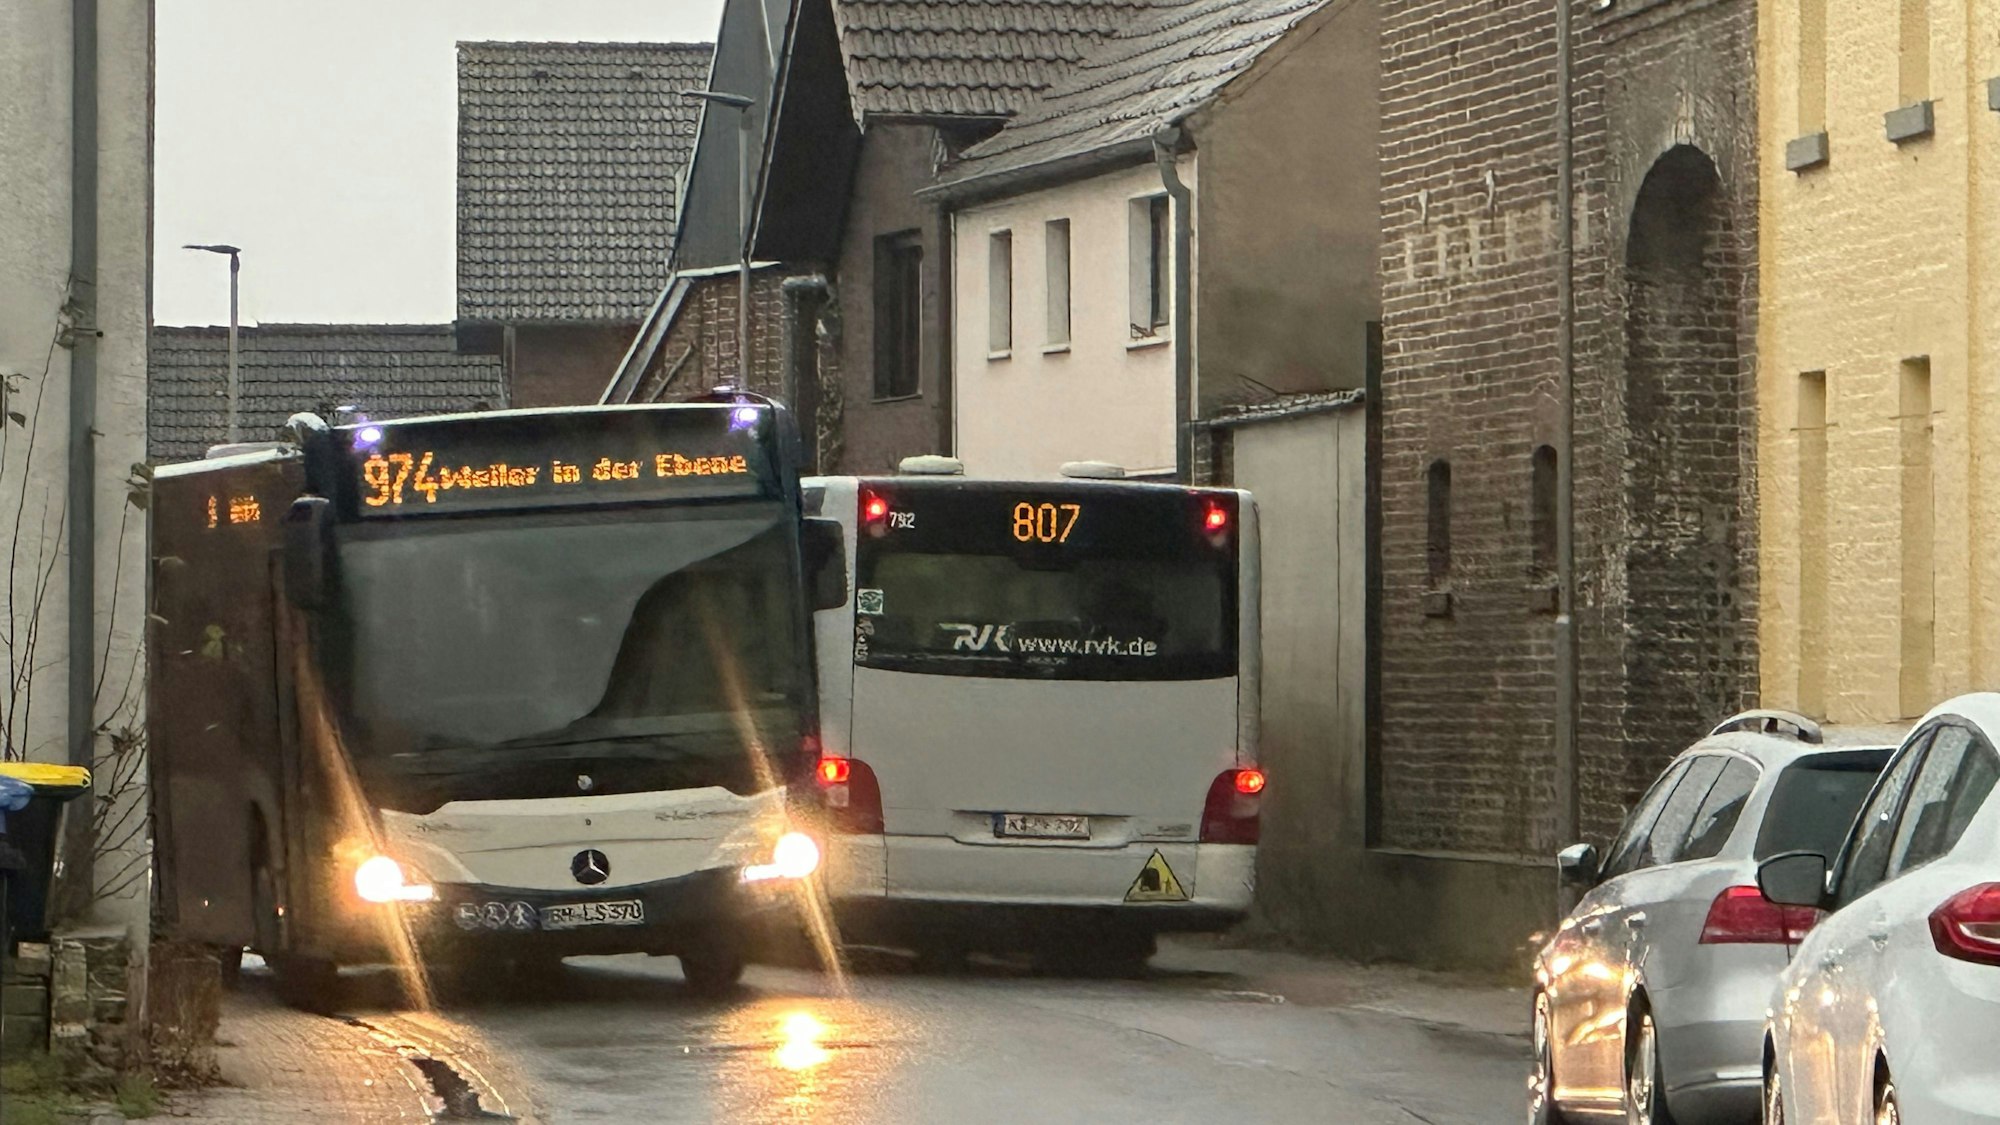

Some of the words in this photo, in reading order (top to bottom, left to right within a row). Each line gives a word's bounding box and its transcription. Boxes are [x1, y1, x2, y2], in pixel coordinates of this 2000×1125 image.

[363, 452, 439, 506] 974
[553, 461, 581, 483] in
[592, 457, 643, 481] der
[655, 454, 748, 477] Ebene
[1013, 502, 1081, 543] 807
[1017, 635, 1157, 656] www.rvk.de
